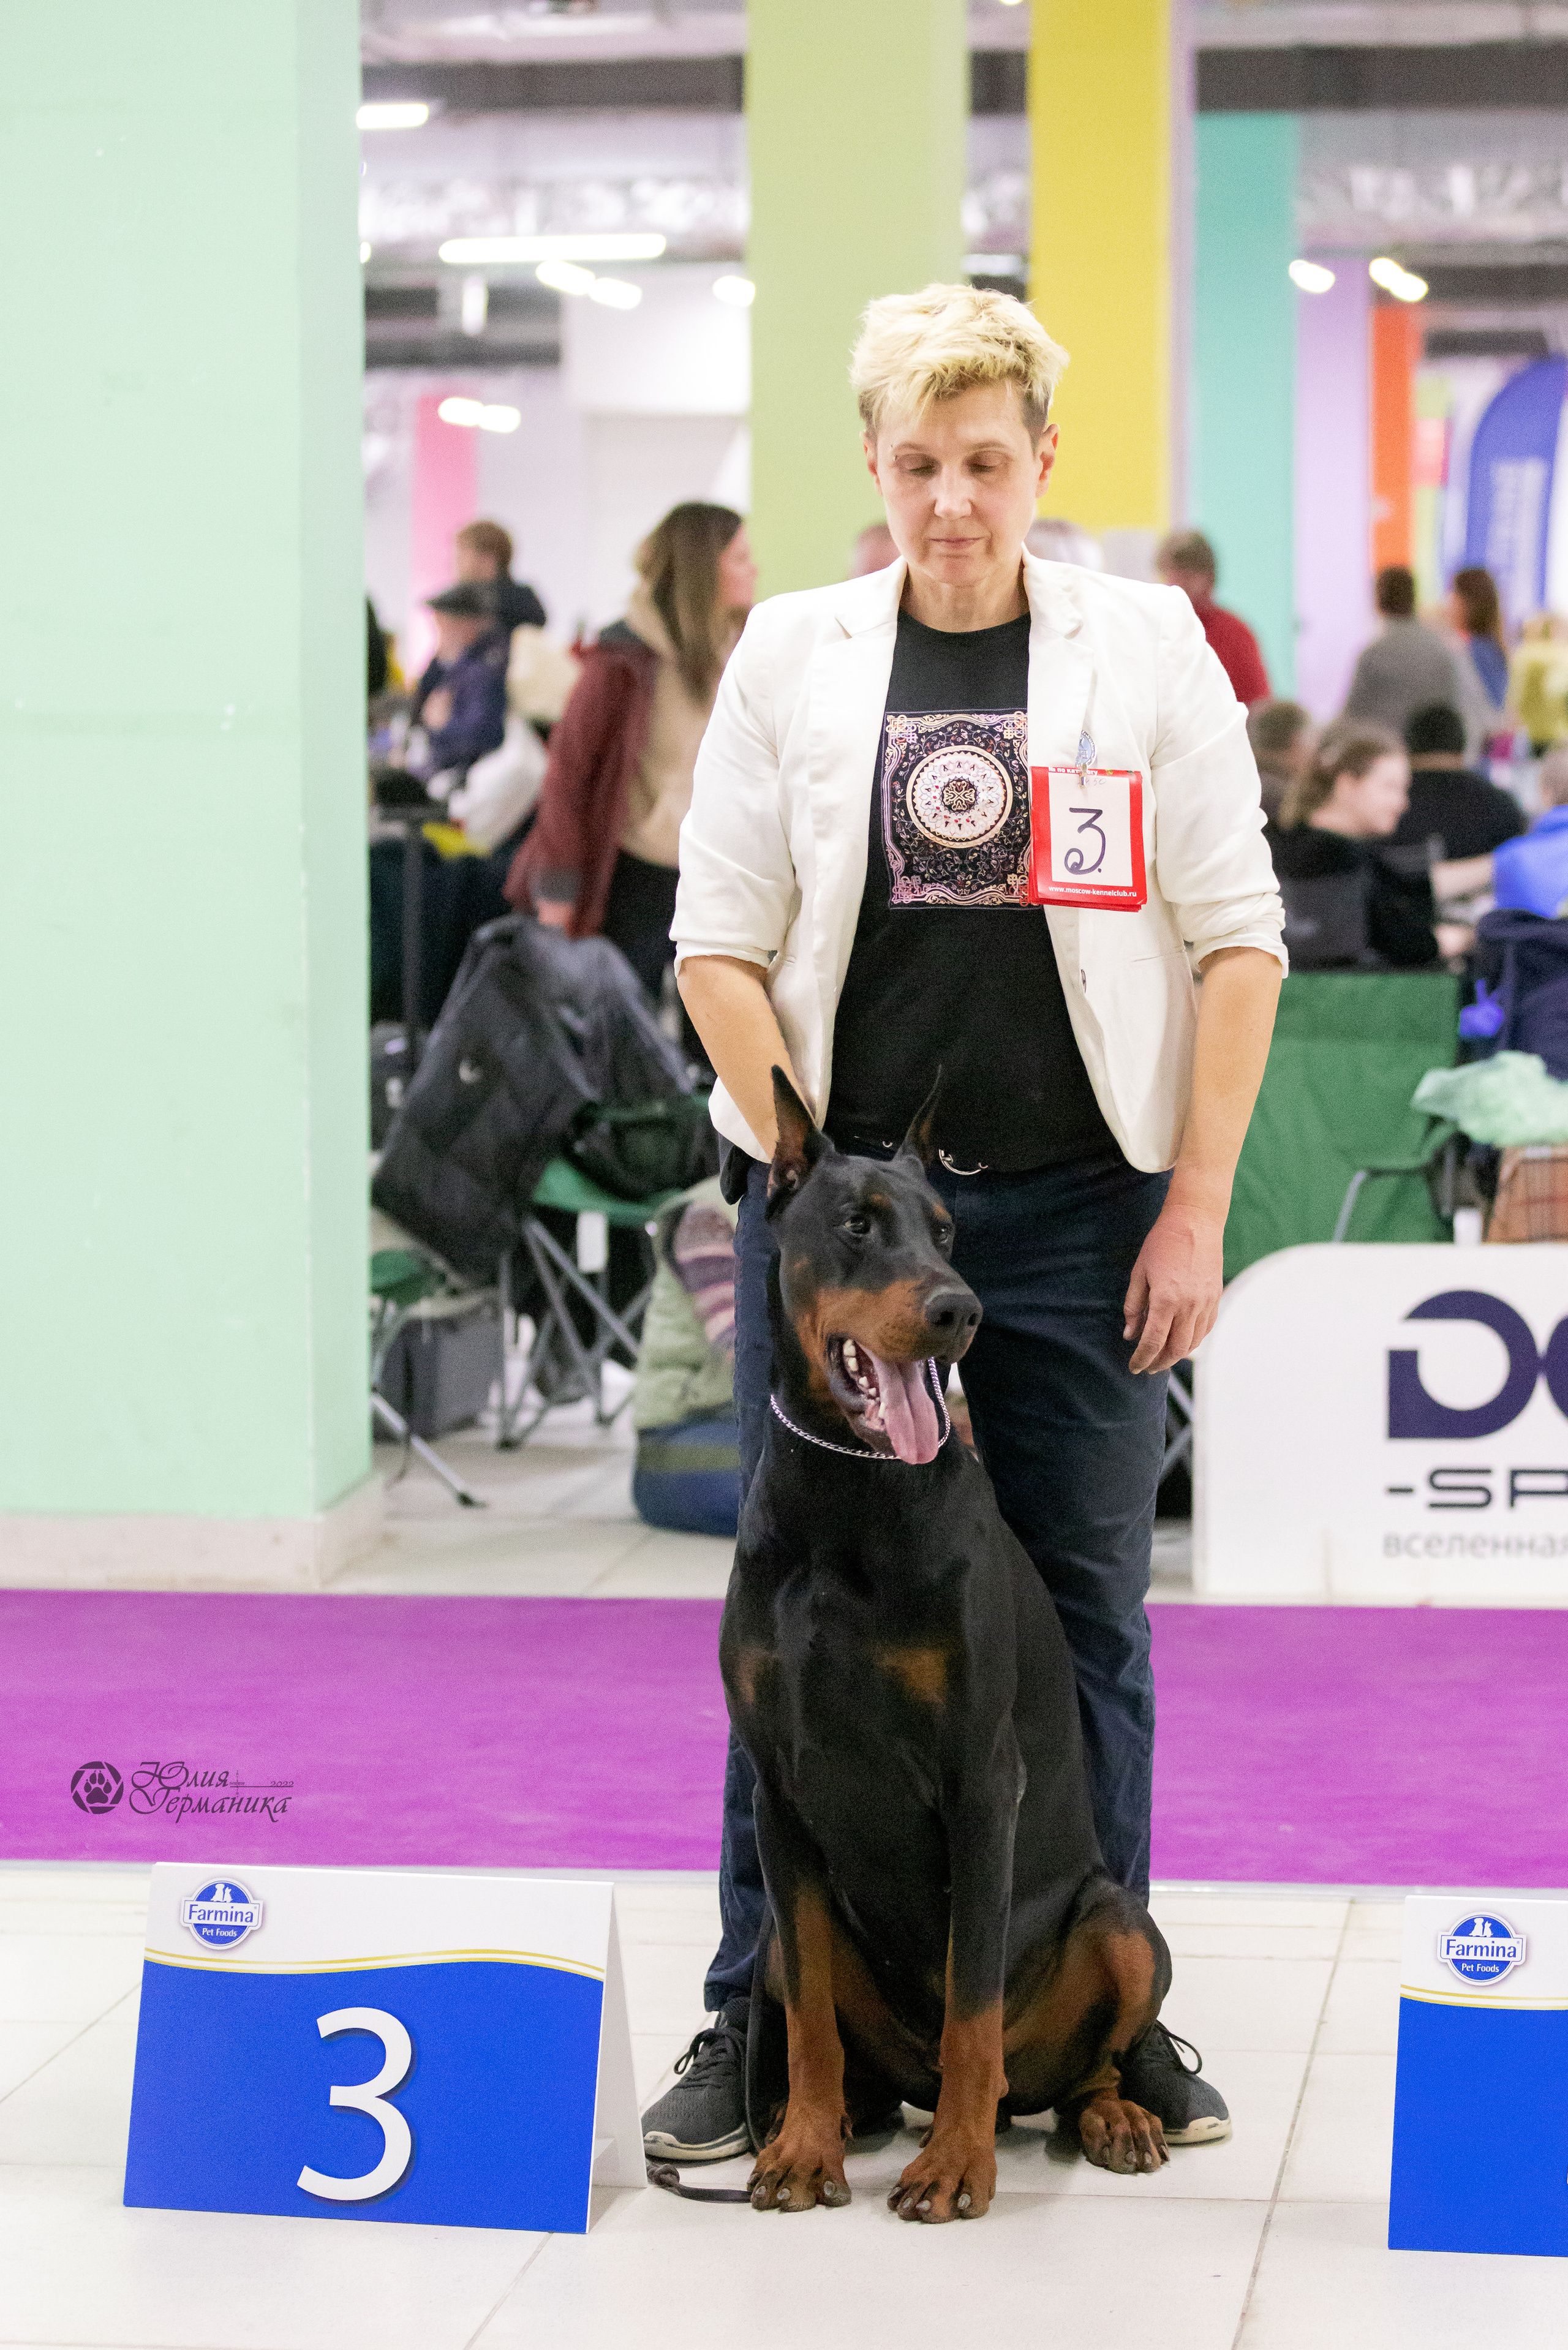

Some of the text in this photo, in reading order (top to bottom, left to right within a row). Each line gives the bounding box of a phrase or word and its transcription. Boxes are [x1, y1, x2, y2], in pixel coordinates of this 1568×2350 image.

[1048, 886, 1137, 897] www.moscow-kennelclub.ru
[1388, 1290, 1568, 1439] D
[189, 1904, 254, 1923] Farmina
[202, 1927, 238, 1937] Pet Foods
[1446, 1939, 1517, 1958] Farmina
[1461, 1963, 1499, 1973] Pet Foods
[296, 2006, 412, 2202] 3
